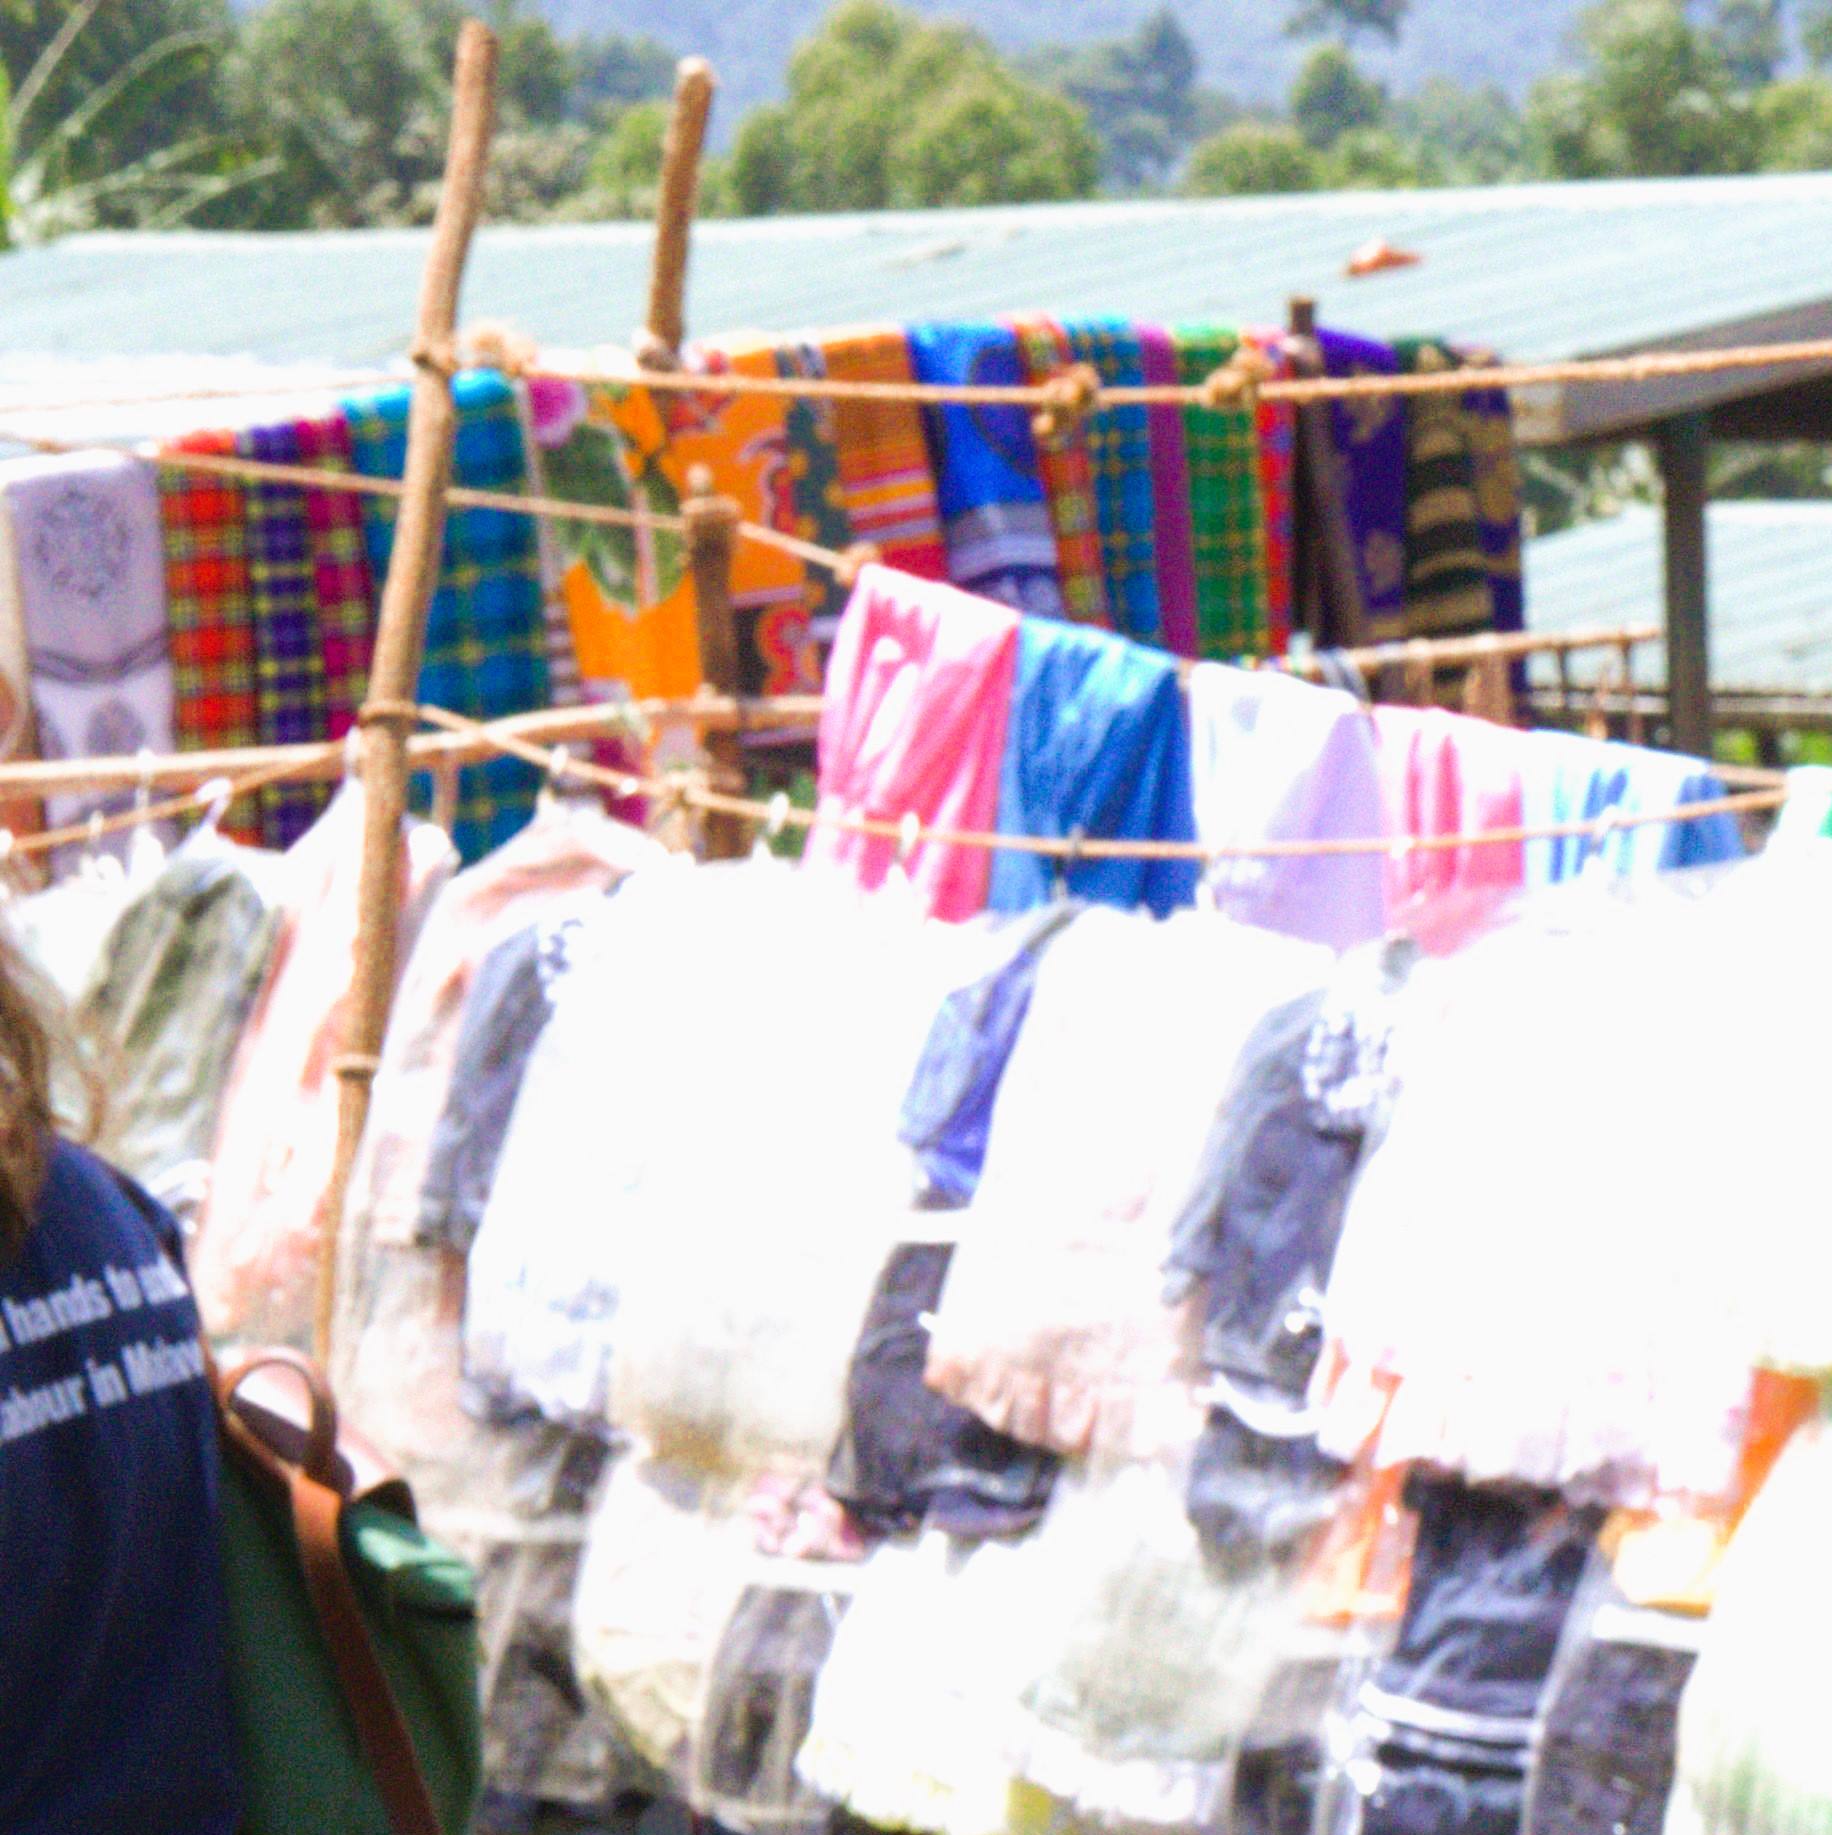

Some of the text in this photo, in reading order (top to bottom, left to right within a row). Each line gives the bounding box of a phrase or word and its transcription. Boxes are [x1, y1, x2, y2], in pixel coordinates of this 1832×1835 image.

[2, 1274, 113, 1345] hands
[104, 1265, 143, 1311] to
[0, 1374, 87, 1440] abour
[85, 1356, 130, 1408] in
